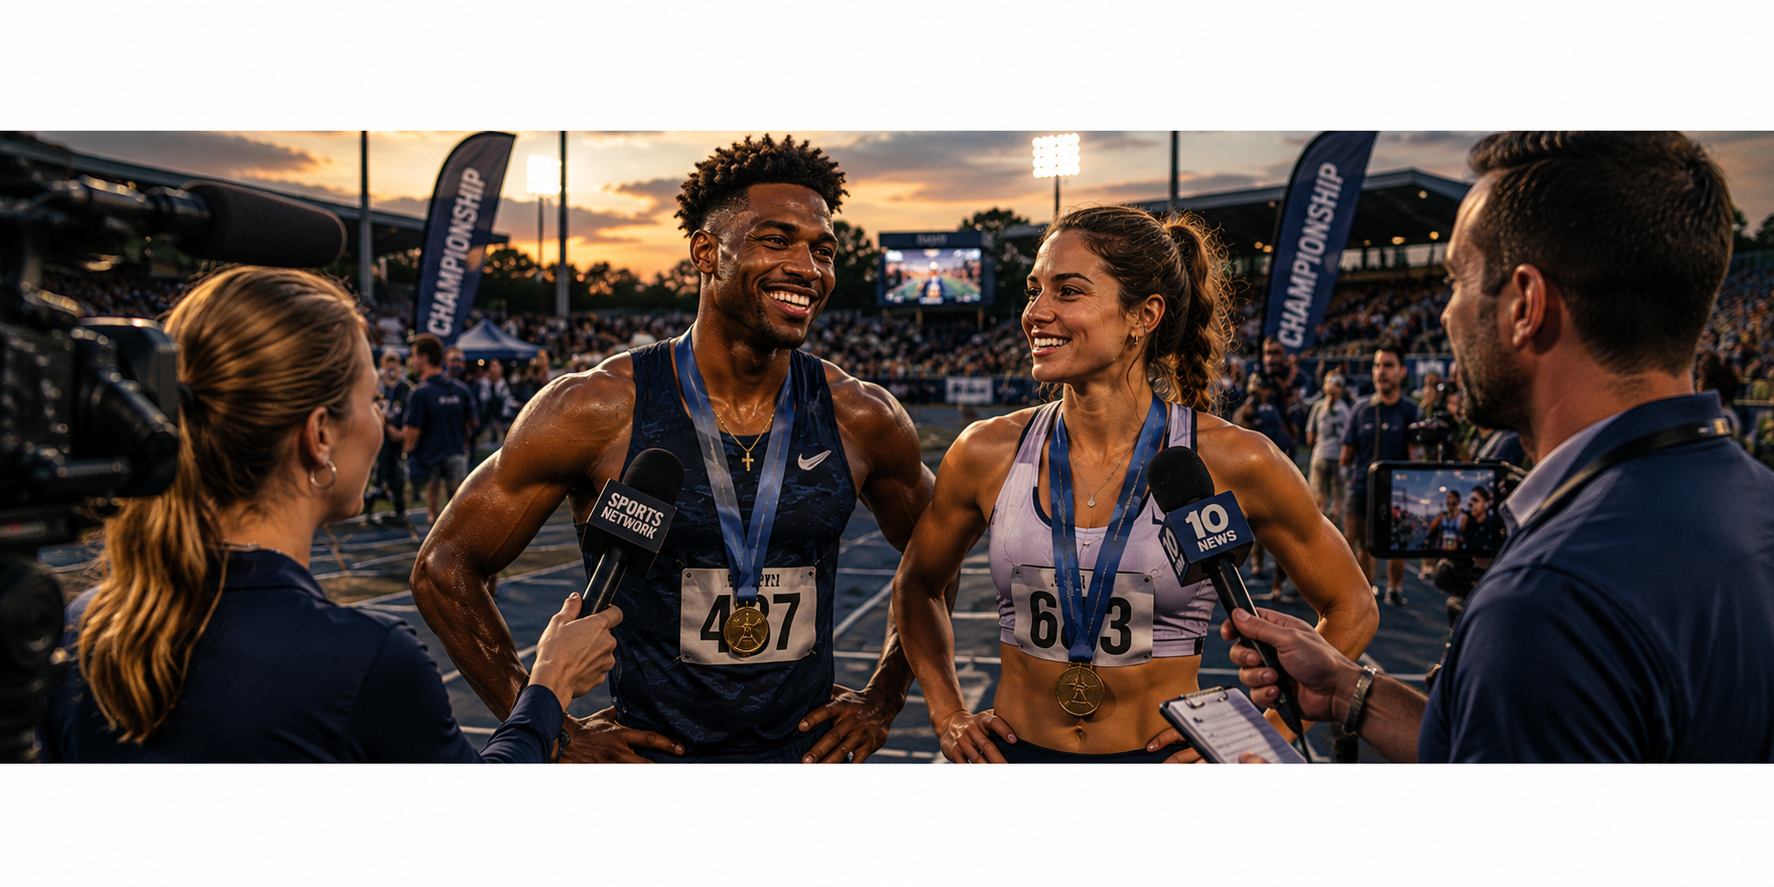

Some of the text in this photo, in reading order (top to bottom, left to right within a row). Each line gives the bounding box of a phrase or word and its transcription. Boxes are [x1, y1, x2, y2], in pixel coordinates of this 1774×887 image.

[427, 167, 486, 337] CHAMPIONSHIP
[1277, 162, 1344, 348] CHAMPIONSHIP
[601, 506, 658, 539] NETWORK
[608, 492, 664, 527] SPORTS
[1185, 503, 1229, 539] 10
[1197, 530, 1237, 553] NEWS
[1030, 591, 1132, 655] 63
